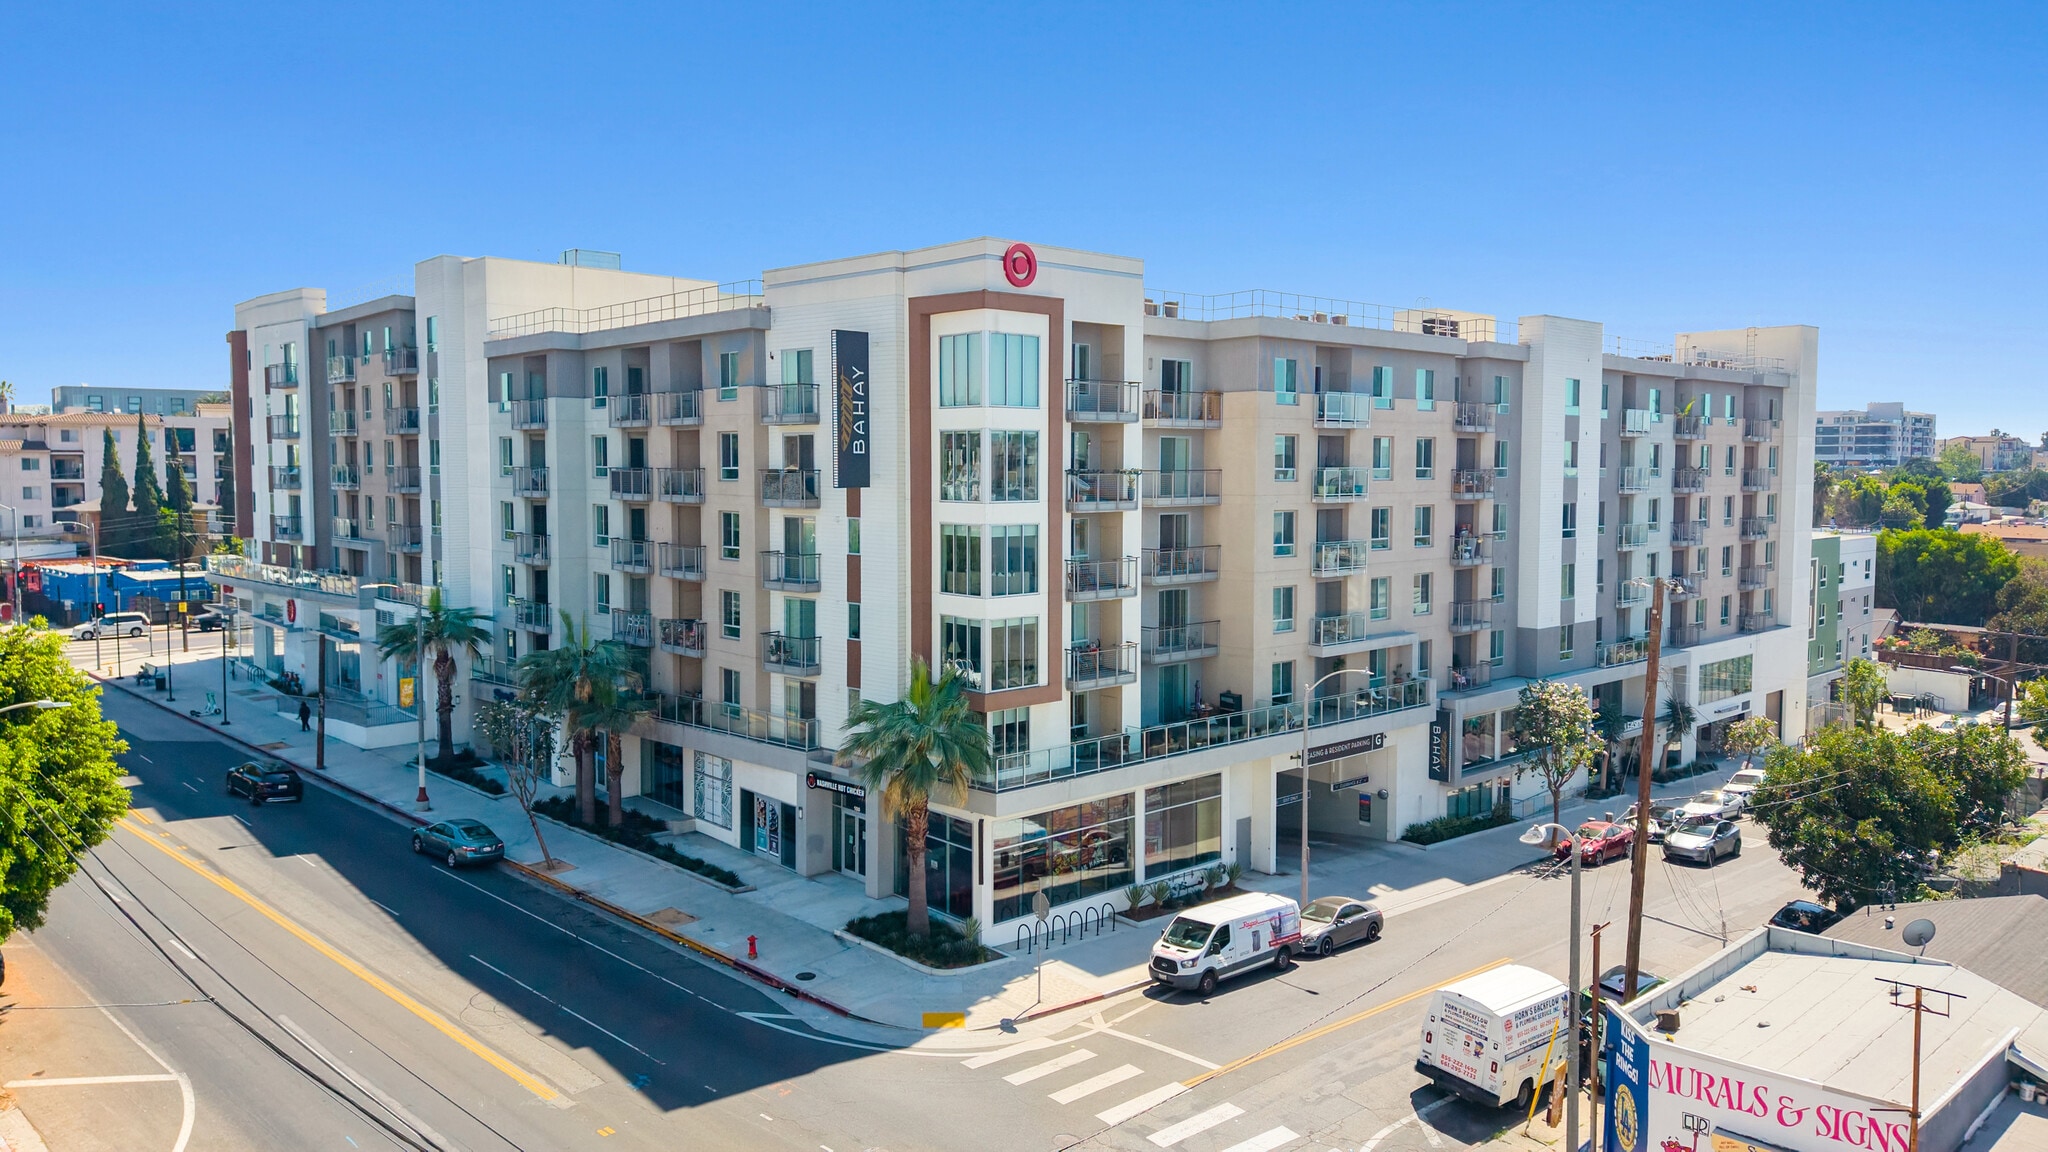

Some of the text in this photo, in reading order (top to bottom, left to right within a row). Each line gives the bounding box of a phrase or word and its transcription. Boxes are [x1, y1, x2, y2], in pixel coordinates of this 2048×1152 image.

[852, 366, 865, 454] BAHAY
[1329, 743, 1350, 754] RESIDENT
[1351, 738, 1370, 749] PARKING
[1375, 734, 1381, 745] G
[1432, 726, 1442, 773] BAHAY
[816, 779, 864, 796] NASHVILLE HOT CHICKEN
[1448, 1010, 1464, 1020] PLUMBING
[1463, 1010, 1488, 1025] BACKFLOW
[1514, 997, 1560, 1022] HORN'S BACKFLOW
[1519, 1014, 1537, 1028] PLUMBING
[1620, 1020, 1635, 1044] KISS
[1621, 1039, 1634, 1062] THE
[1616, 1052, 1638, 1085] RINGS!
[1648, 1060, 1910, 1152] MURALS & SIGNS
